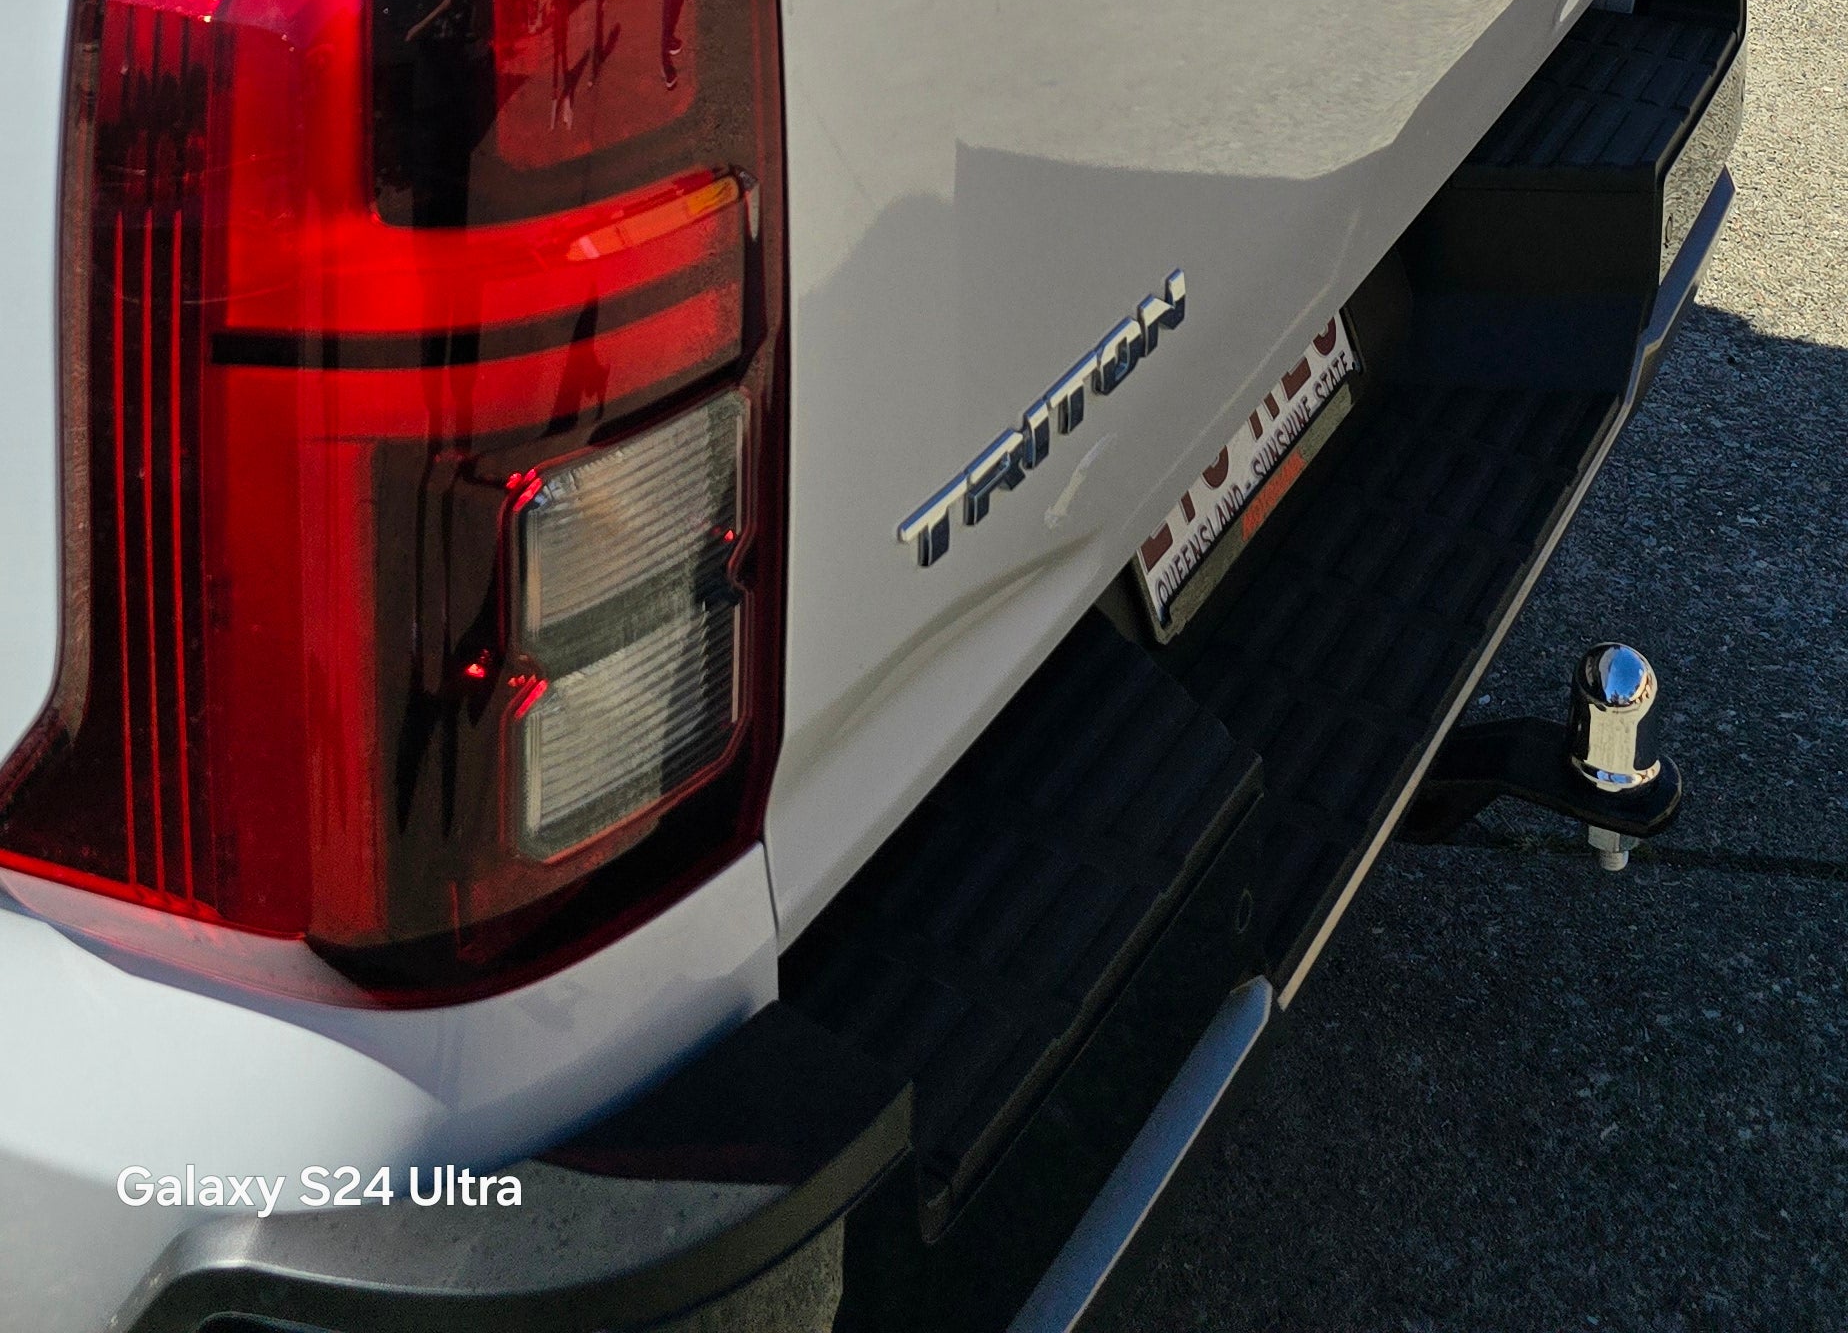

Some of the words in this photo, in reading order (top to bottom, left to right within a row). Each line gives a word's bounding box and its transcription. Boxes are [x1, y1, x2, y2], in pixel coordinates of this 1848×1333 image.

[898, 267, 1185, 568] TRITON
[1156, 484, 1244, 605] QUEENSLAND
[1252, 395, 1312, 478] SUNSHINE
[1313, 351, 1350, 404] STATE
